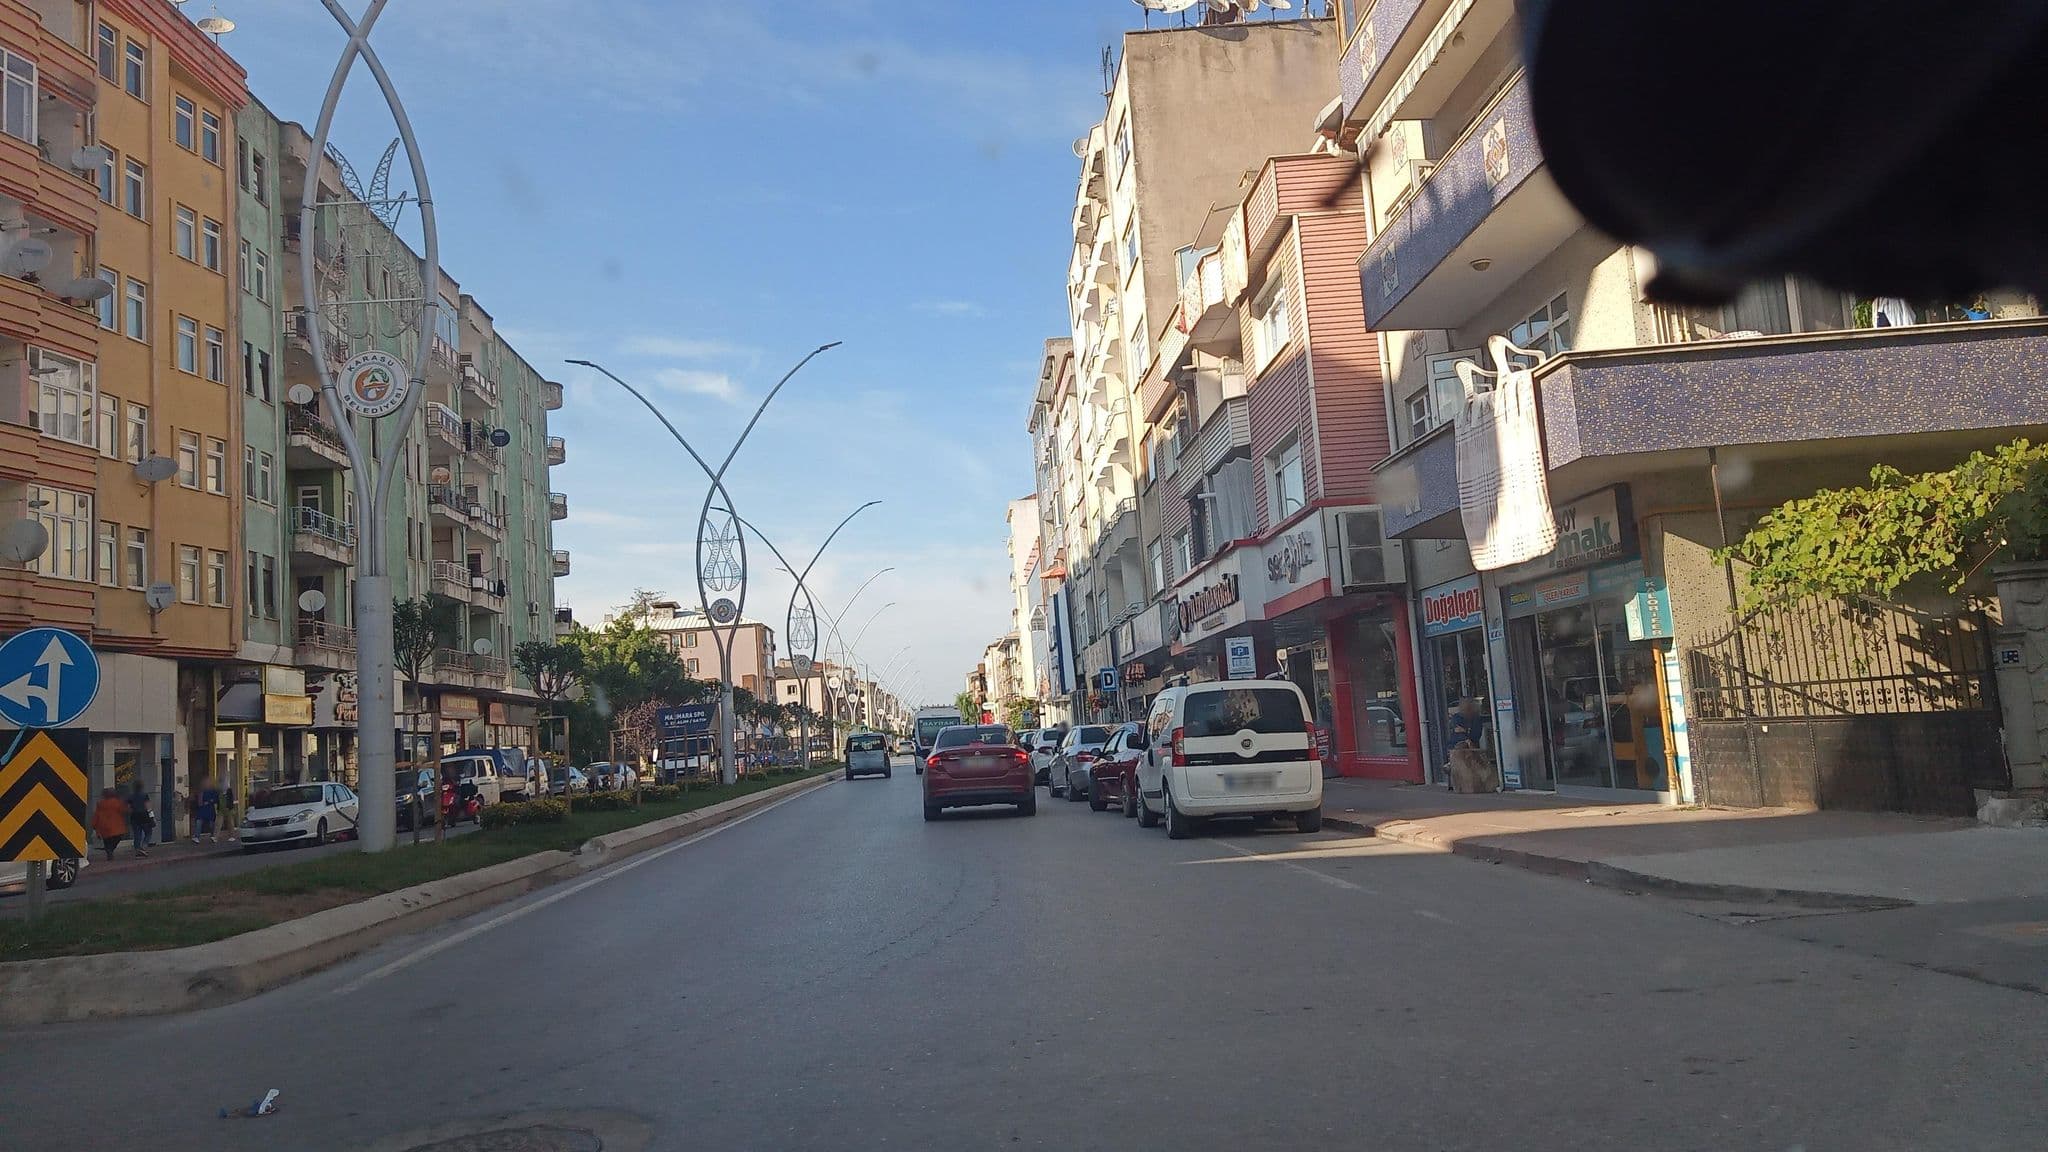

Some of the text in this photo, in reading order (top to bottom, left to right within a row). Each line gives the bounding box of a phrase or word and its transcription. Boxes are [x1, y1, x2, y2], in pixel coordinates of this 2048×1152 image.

[346, 355, 395, 372] KARASU
[343, 387, 404, 414] BELEDİYESİ
[1424, 588, 1480, 624] Doğalgaz
[1104, 673, 1114, 687] D
[664, 712, 693, 721] MAMARA
